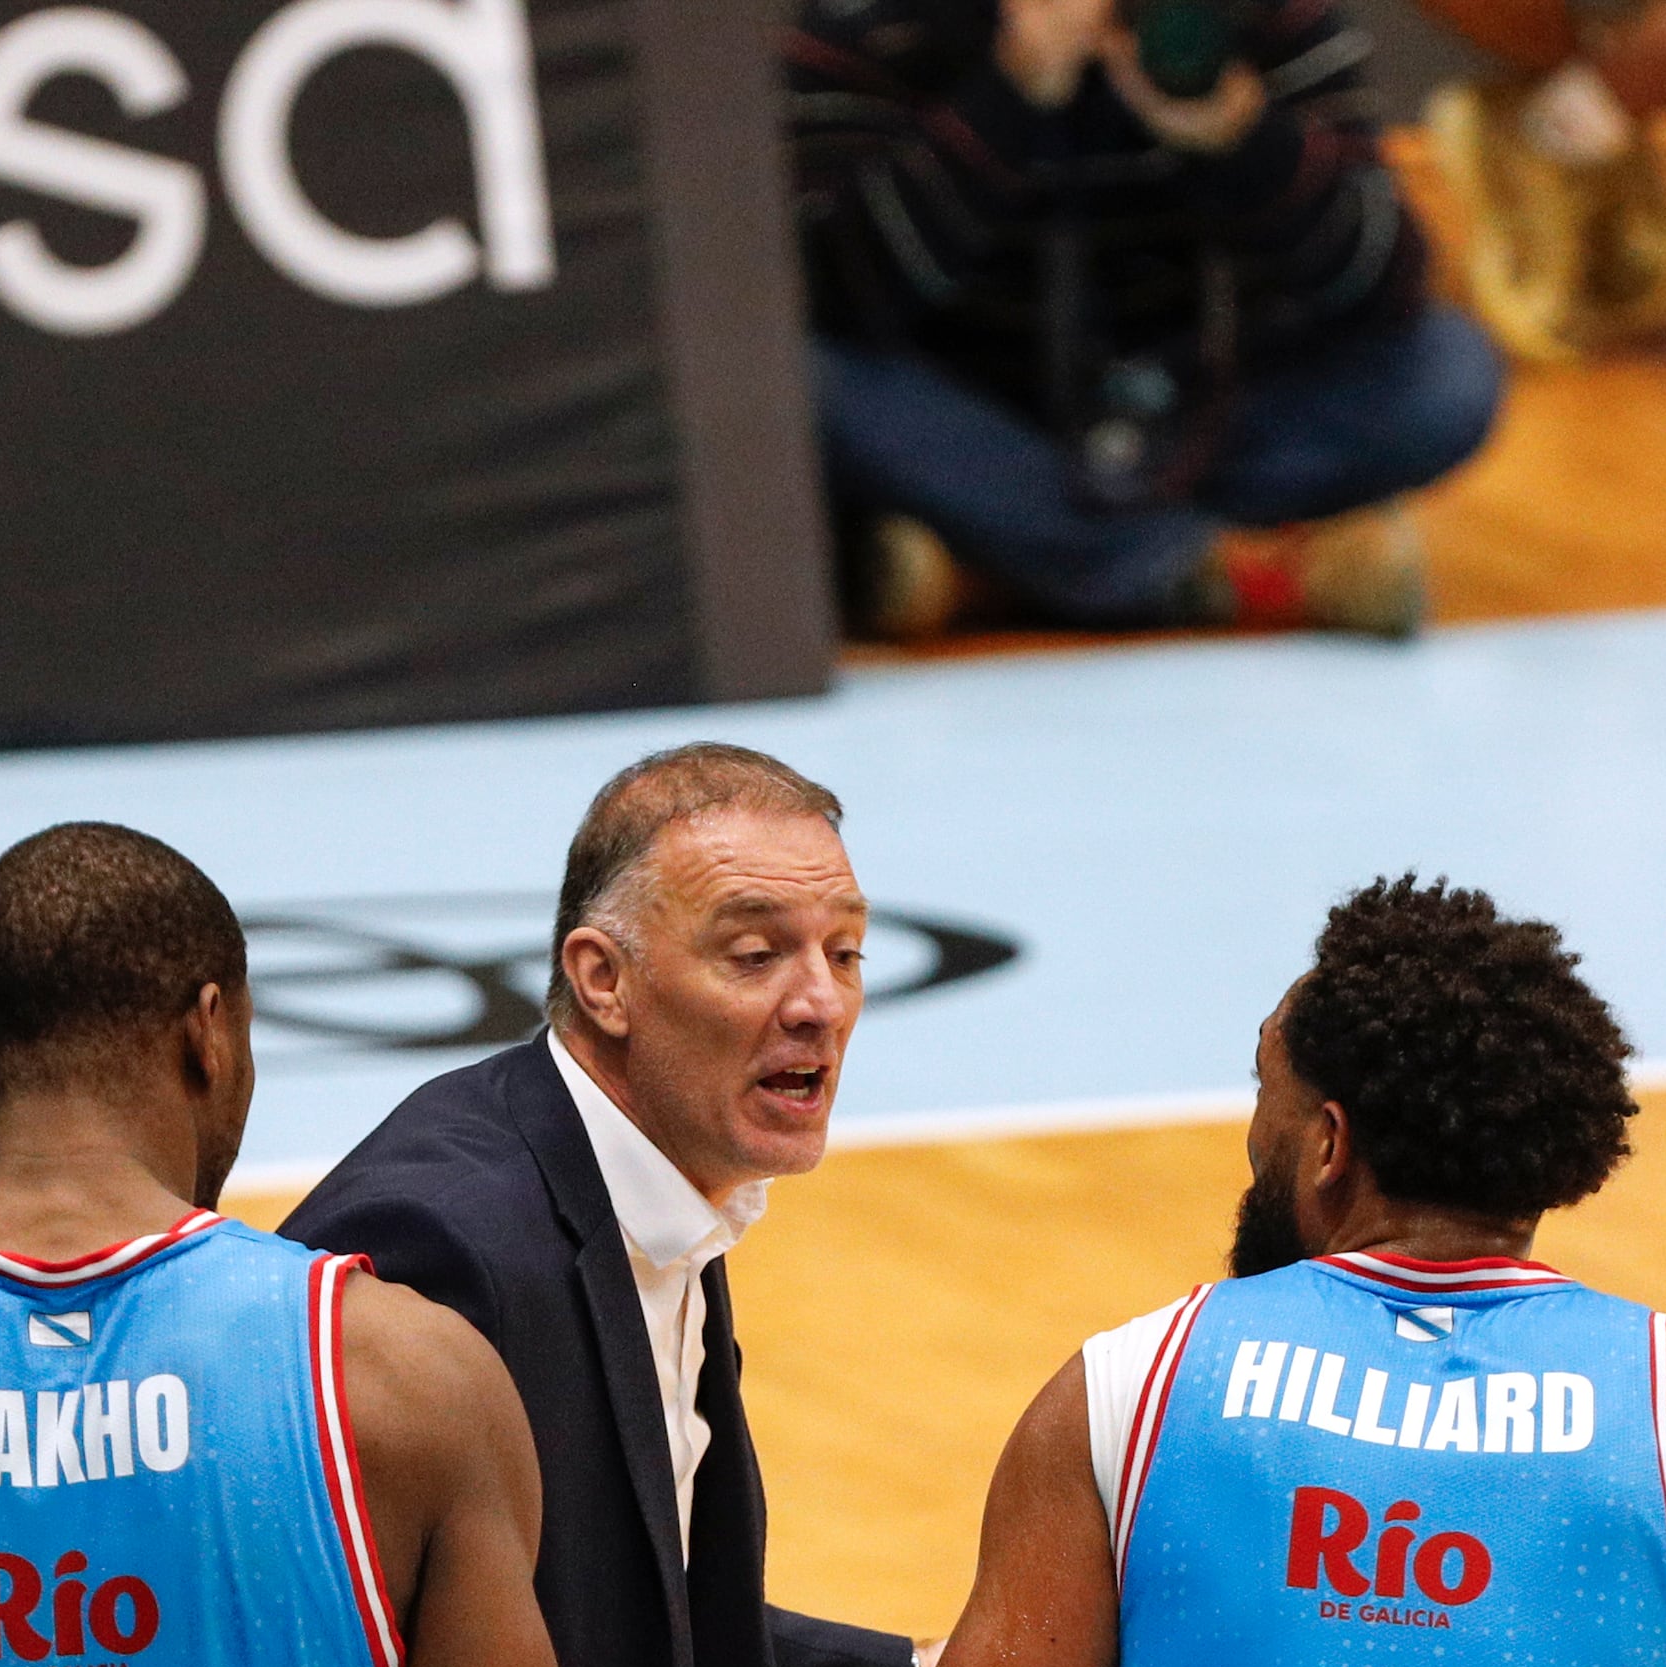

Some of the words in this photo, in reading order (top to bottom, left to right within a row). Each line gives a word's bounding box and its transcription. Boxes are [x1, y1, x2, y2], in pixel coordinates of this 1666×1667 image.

[1222, 1341, 1595, 1453] HILLIARD
[1286, 1487, 1491, 1605] Río
[1320, 1602, 1350, 1621] DE
[1360, 1605, 1450, 1629] GALICIA
